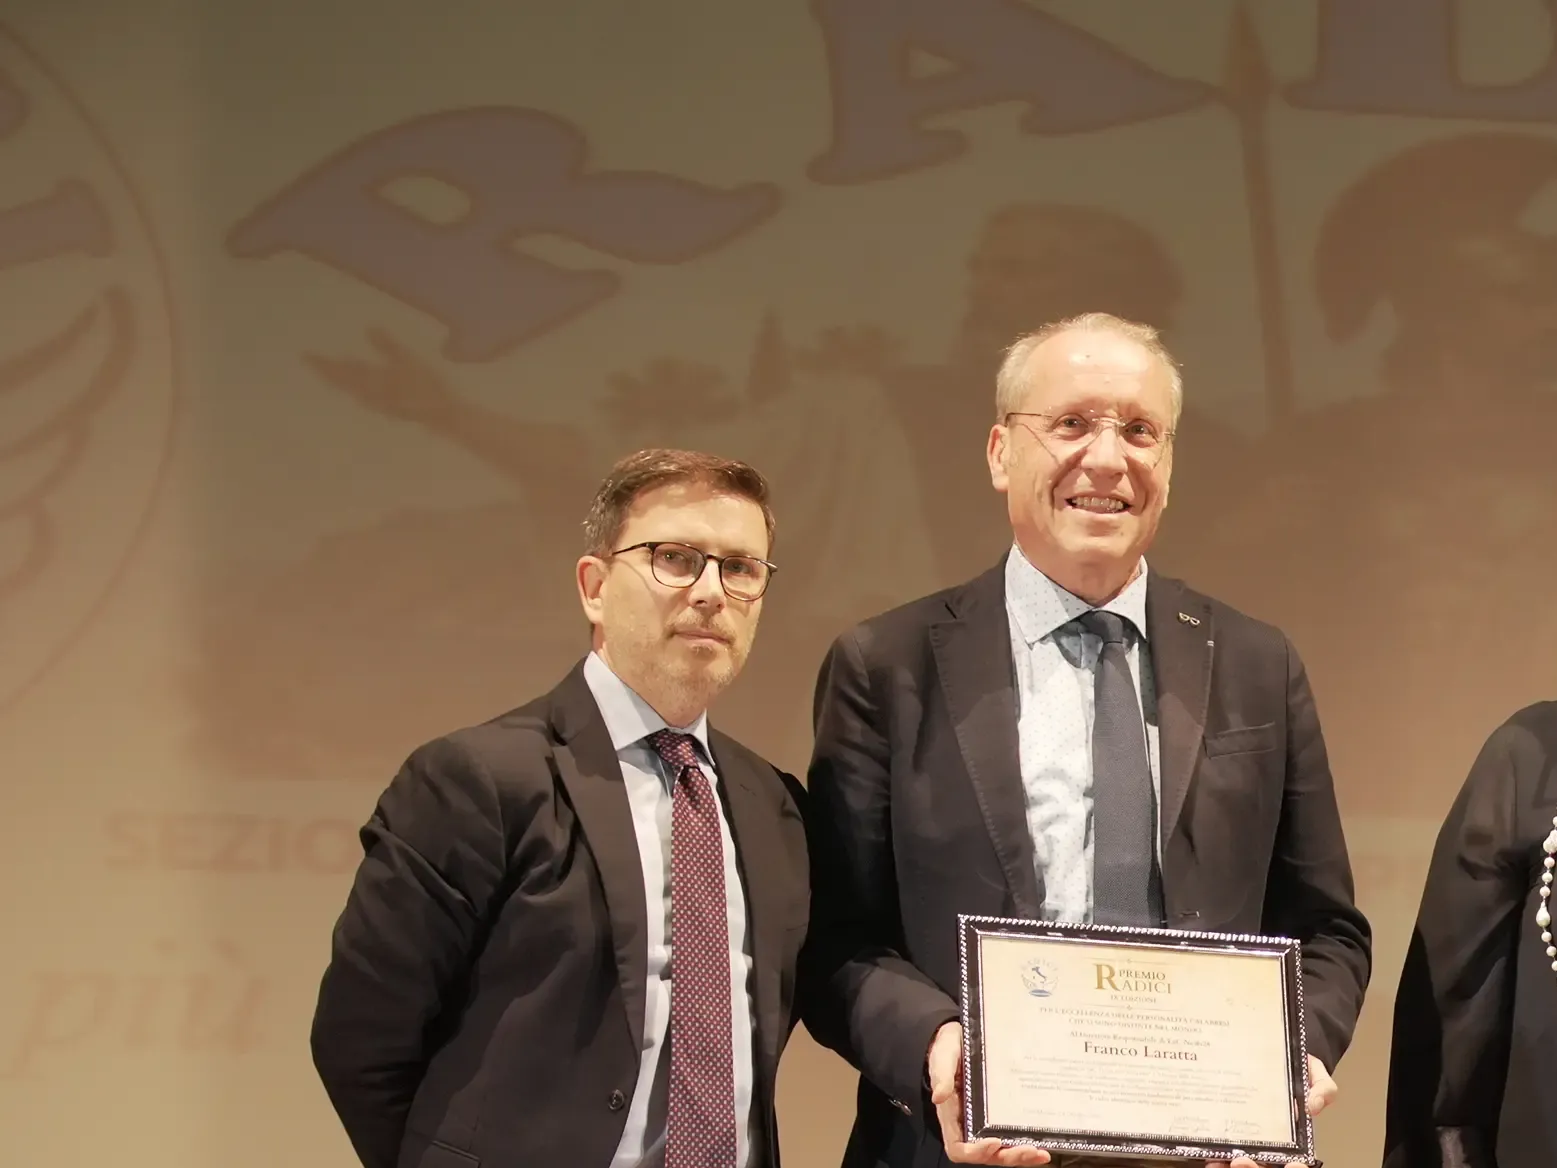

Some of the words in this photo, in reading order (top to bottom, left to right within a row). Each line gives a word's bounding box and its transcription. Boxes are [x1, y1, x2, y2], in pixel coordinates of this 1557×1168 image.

[1093, 963, 1173, 994] RADICI
[1118, 969, 1166, 981] PREMIO
[1083, 1040, 1138, 1057] Franco
[1144, 1044, 1198, 1061] Laratta
